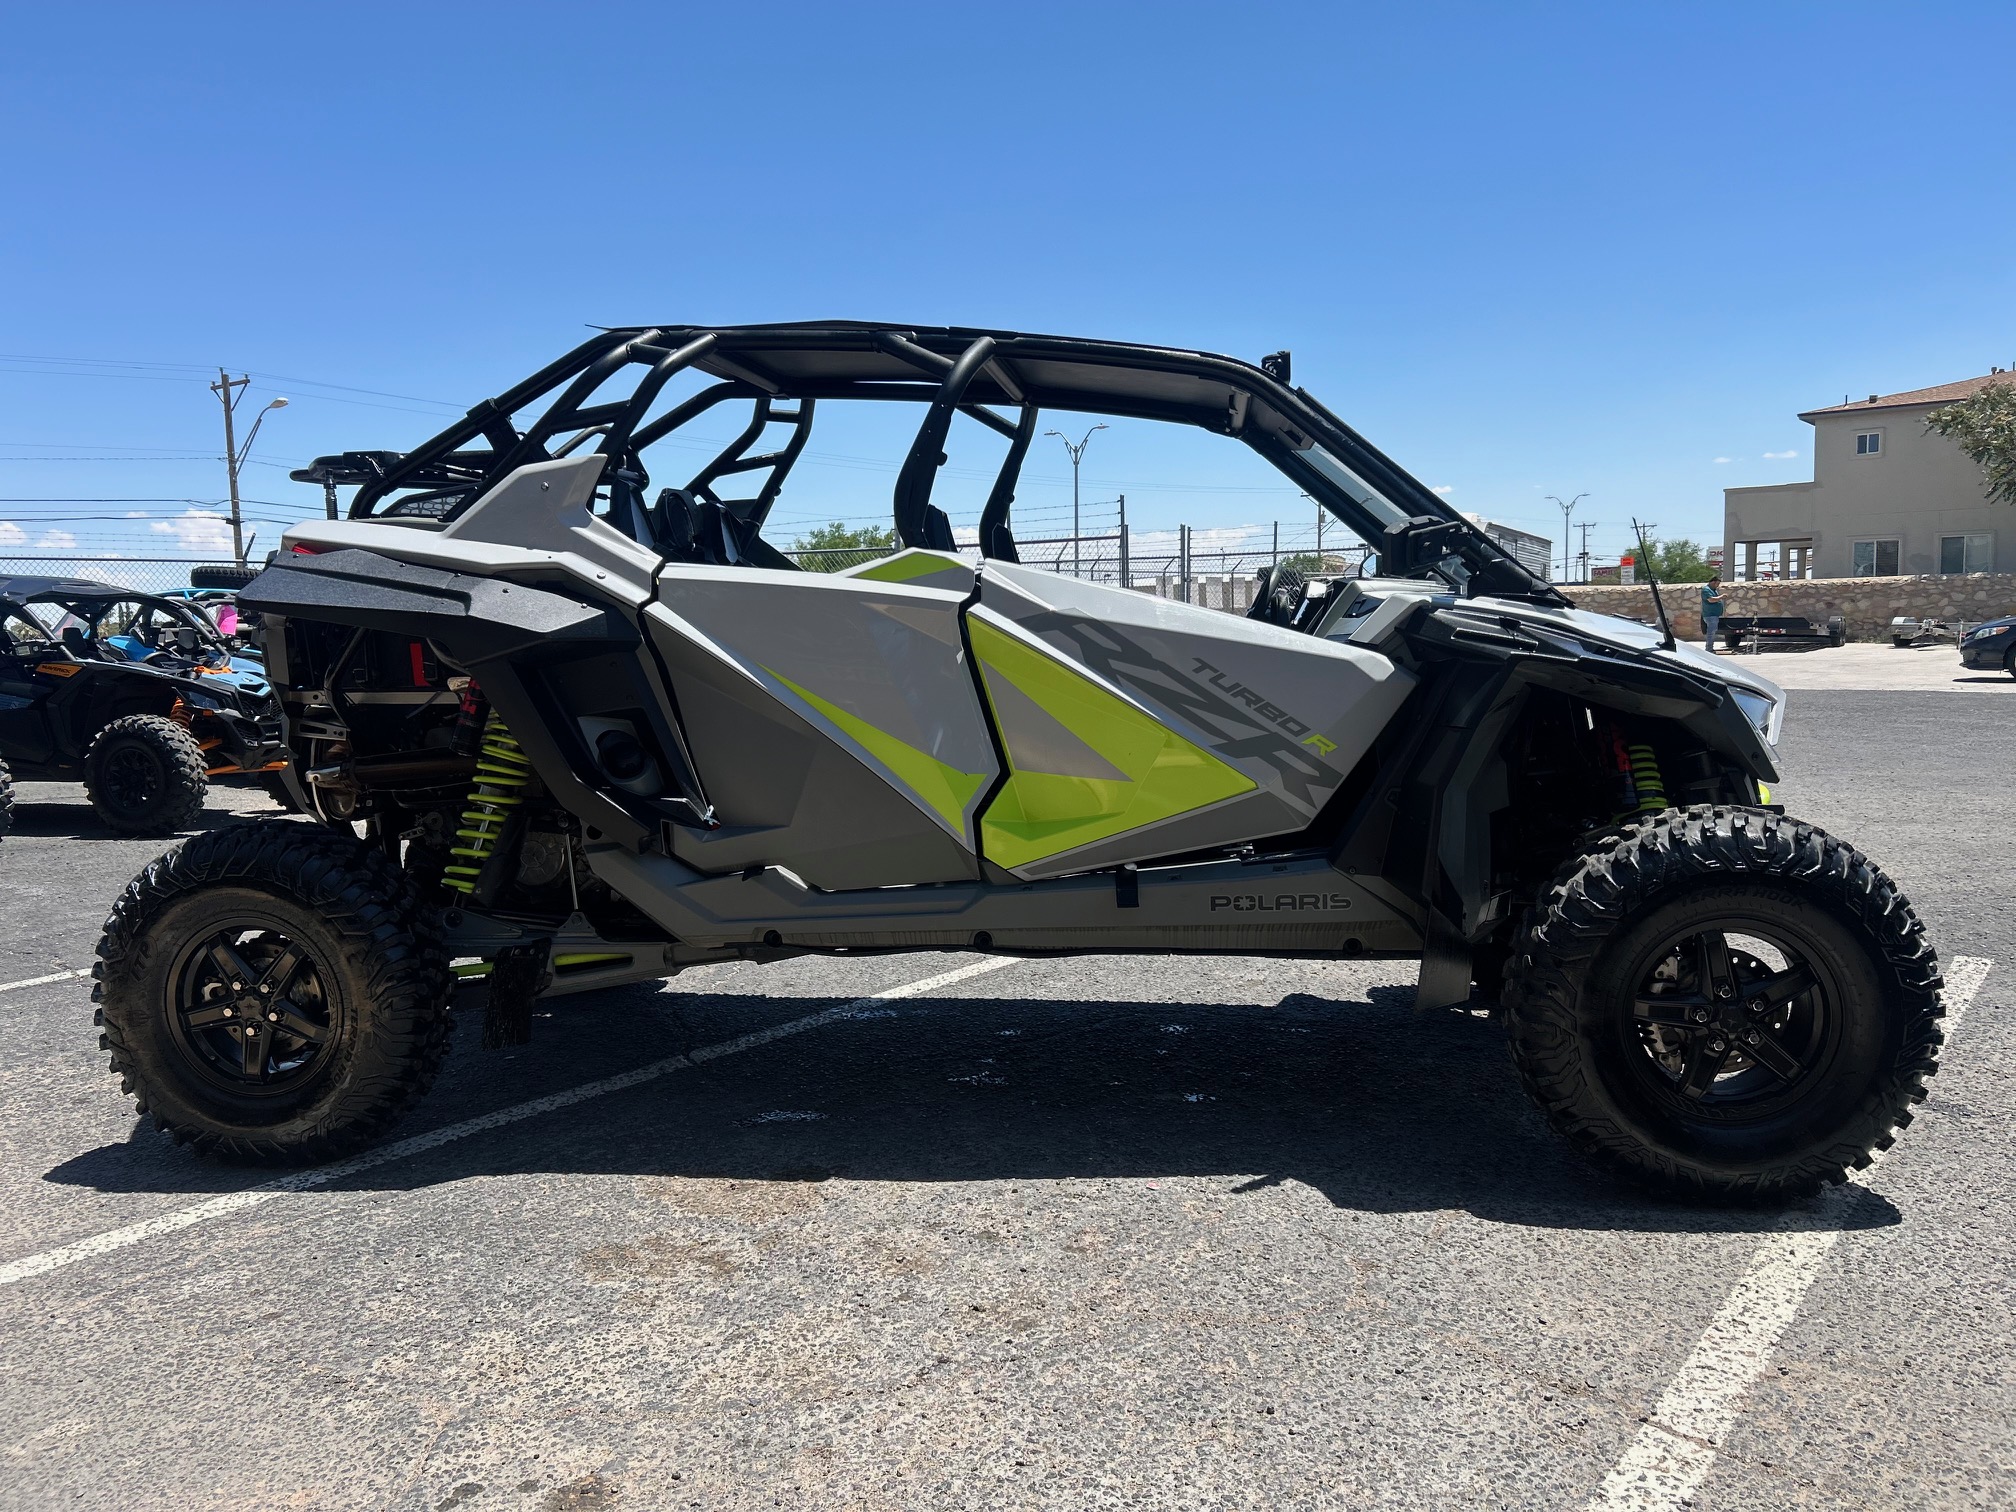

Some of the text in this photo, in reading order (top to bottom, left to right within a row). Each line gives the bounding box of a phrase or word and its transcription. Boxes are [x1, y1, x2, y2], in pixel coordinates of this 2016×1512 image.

[1015, 610, 1344, 810] RZR
[1192, 658, 1338, 757] TURBO R
[1209, 893, 1352, 911] POLARIS
[1682, 887, 1807, 909] TERRA HOOK
[130, 942, 152, 982] ITP
[344, 1007, 359, 1063] TERRA
